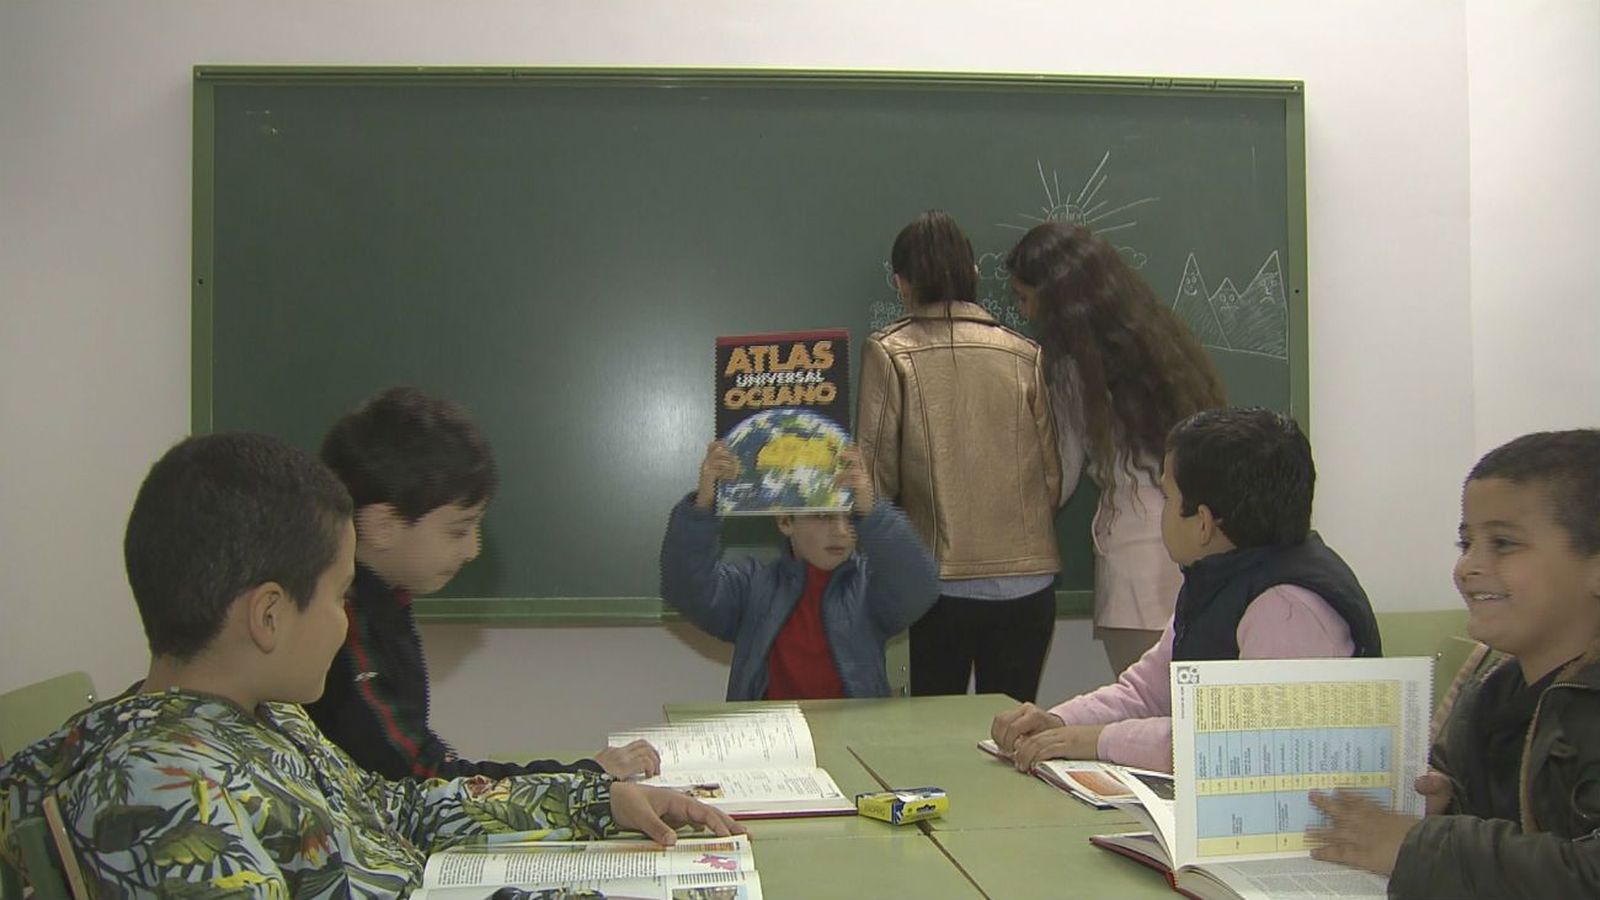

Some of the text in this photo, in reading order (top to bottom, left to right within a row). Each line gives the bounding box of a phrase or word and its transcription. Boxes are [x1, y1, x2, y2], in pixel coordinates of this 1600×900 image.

[725, 341, 834, 374] ATLAS
[736, 370, 825, 388] UNIVERSAL
[724, 383, 837, 410] OCEANO
